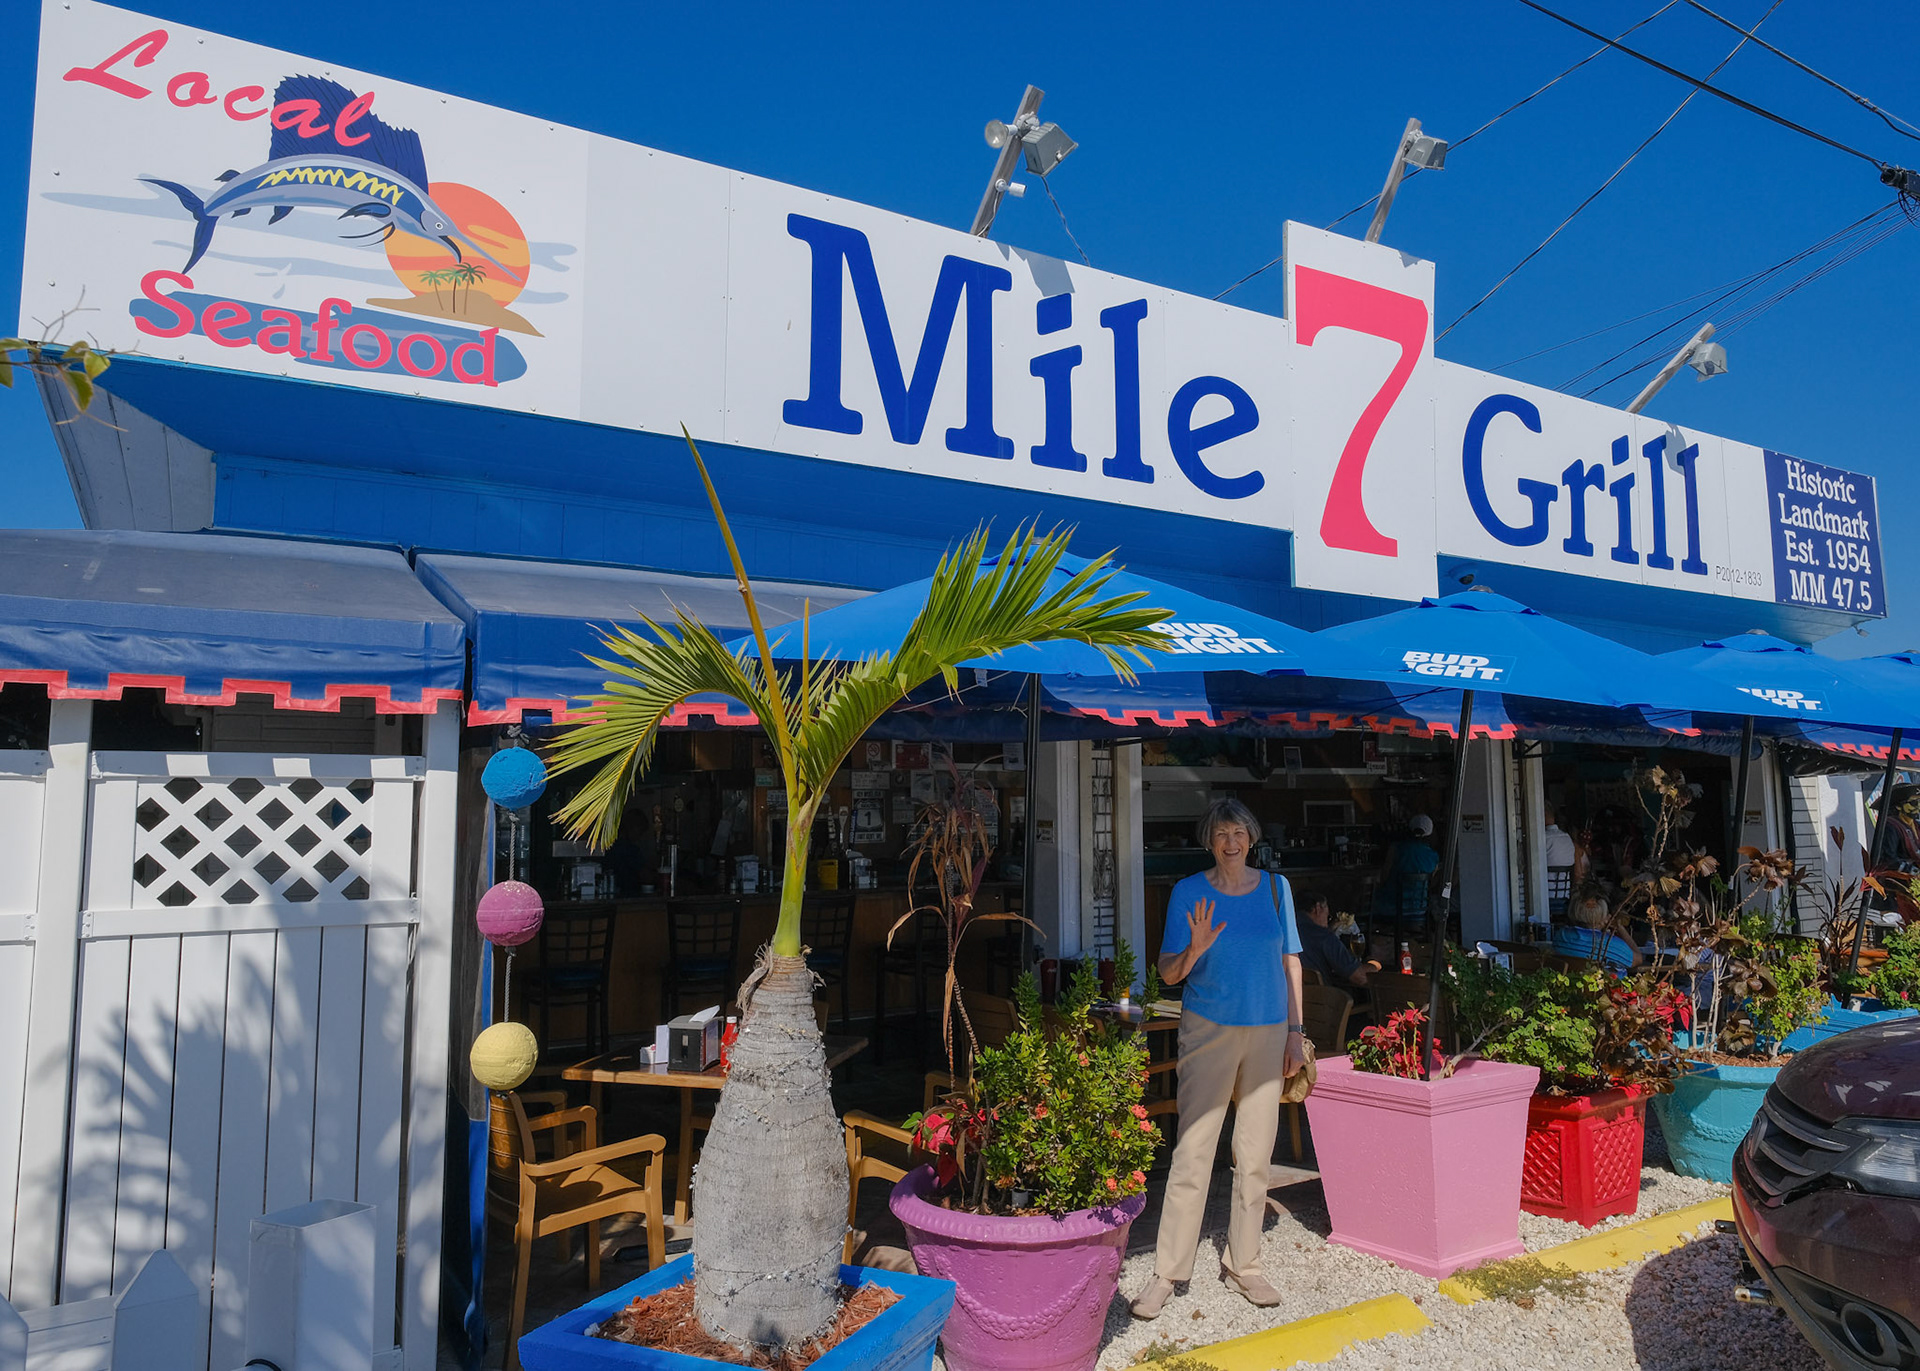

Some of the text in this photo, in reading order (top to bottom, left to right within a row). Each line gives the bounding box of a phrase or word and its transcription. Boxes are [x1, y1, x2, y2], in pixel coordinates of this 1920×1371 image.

[62, 28, 375, 147] Local
[133, 269, 501, 388] Seafood
[782, 212, 1708, 576] Mile 7 Grill
[1785, 458, 1857, 505] Historic
[1777, 492, 1871, 541] Landmark
[1783, 529, 1872, 575] Est. 1954
[1715, 565, 1763, 587] P2012-1833
[1789, 569, 1872, 611] MM 47.5
[1146, 621, 1238, 638] BUD
[1401, 650, 1490, 668] BUD
